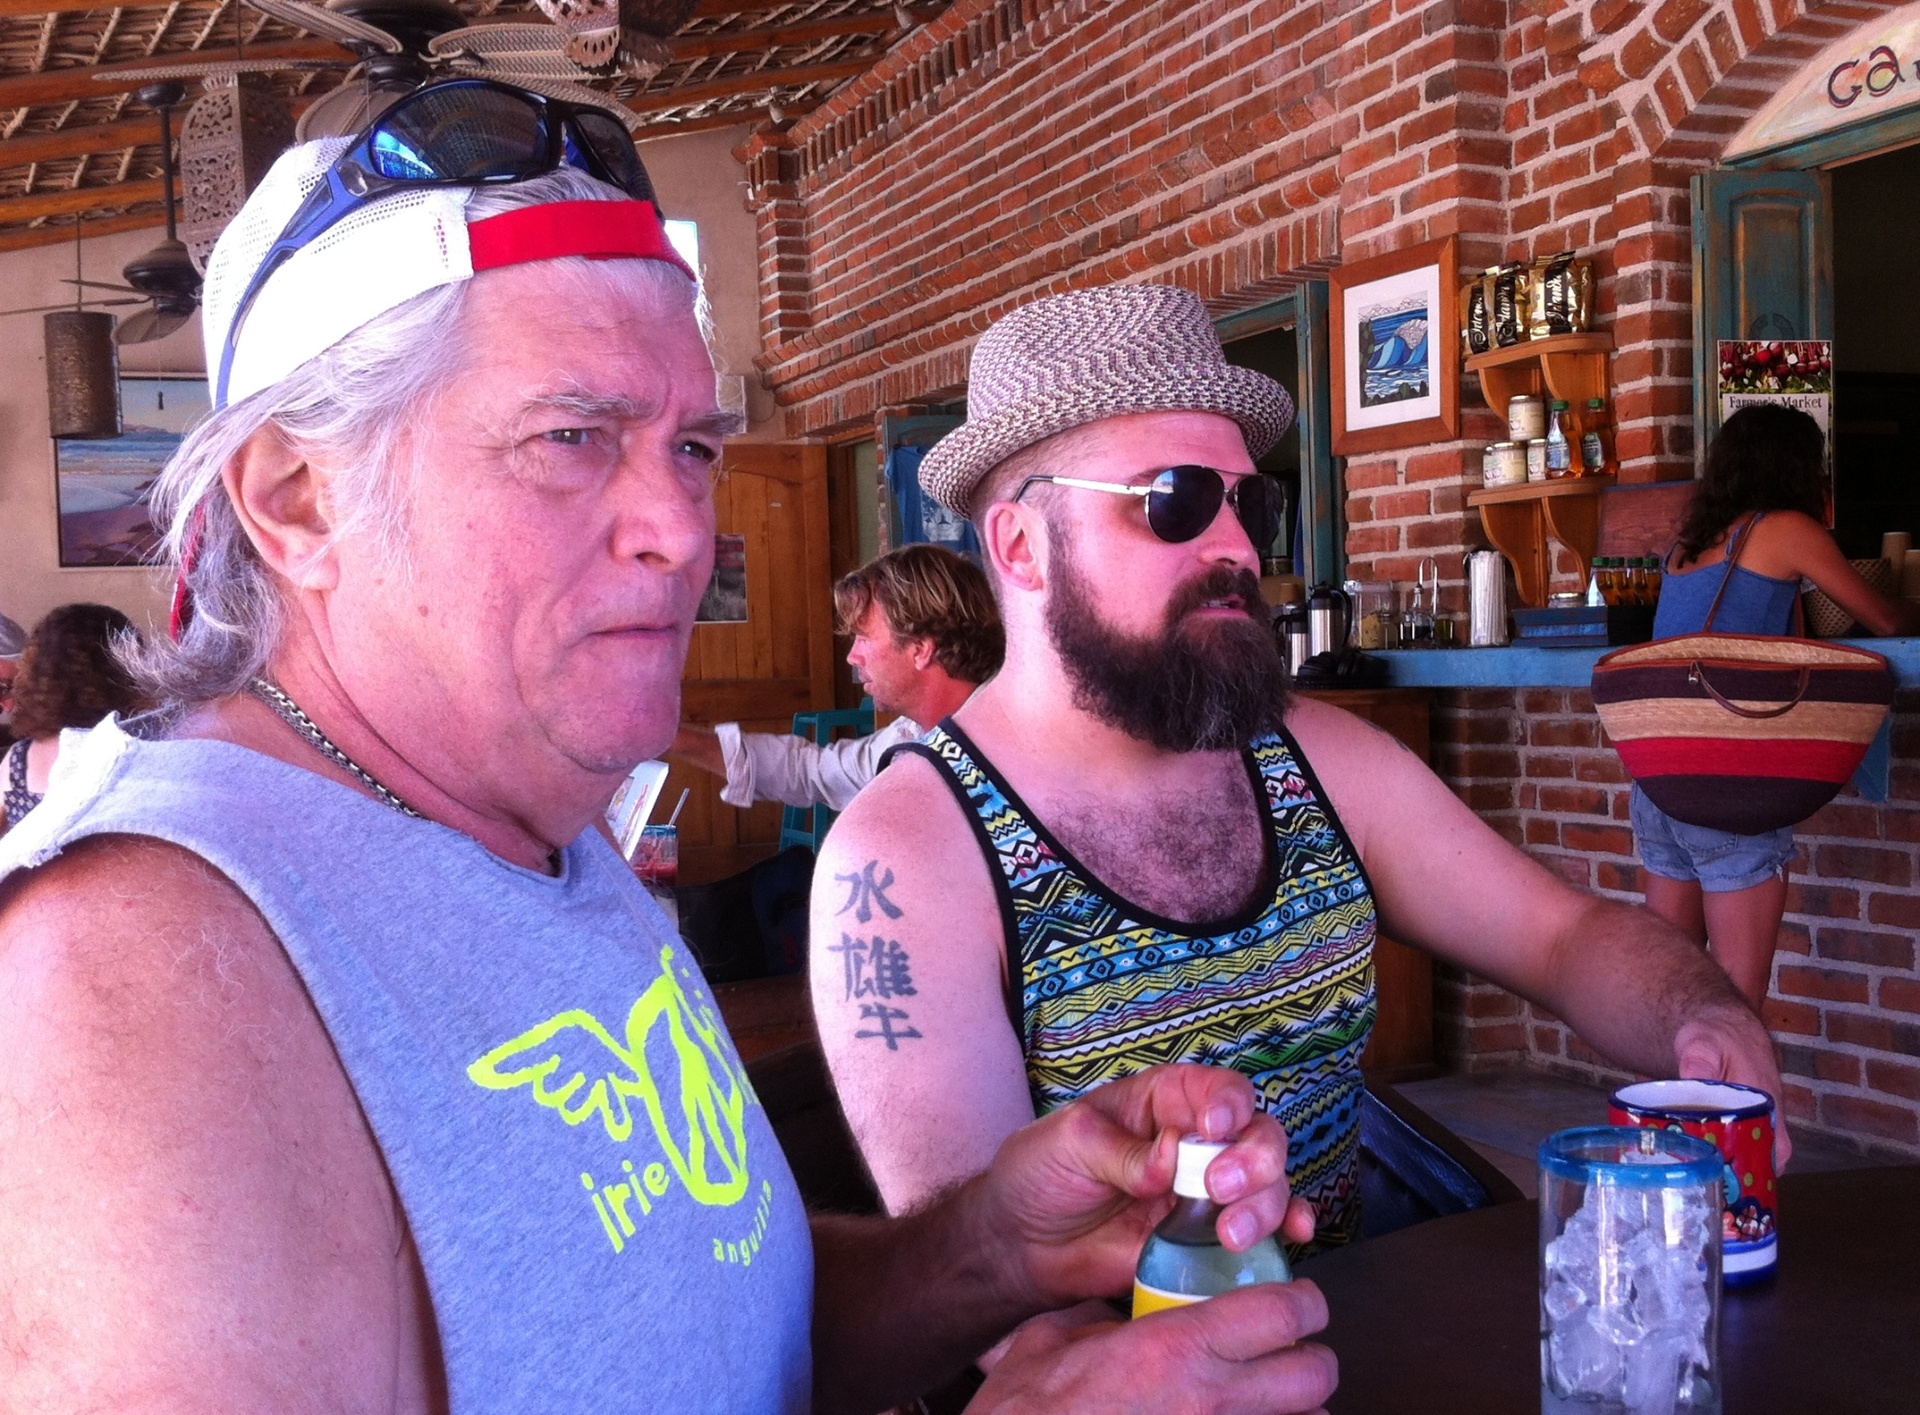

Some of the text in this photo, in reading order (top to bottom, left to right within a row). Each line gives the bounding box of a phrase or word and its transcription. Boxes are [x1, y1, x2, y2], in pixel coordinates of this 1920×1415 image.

[1781, 396, 1822, 410] Market
[581, 1160, 670, 1253] irie
[713, 1179, 772, 1267] anguilla
